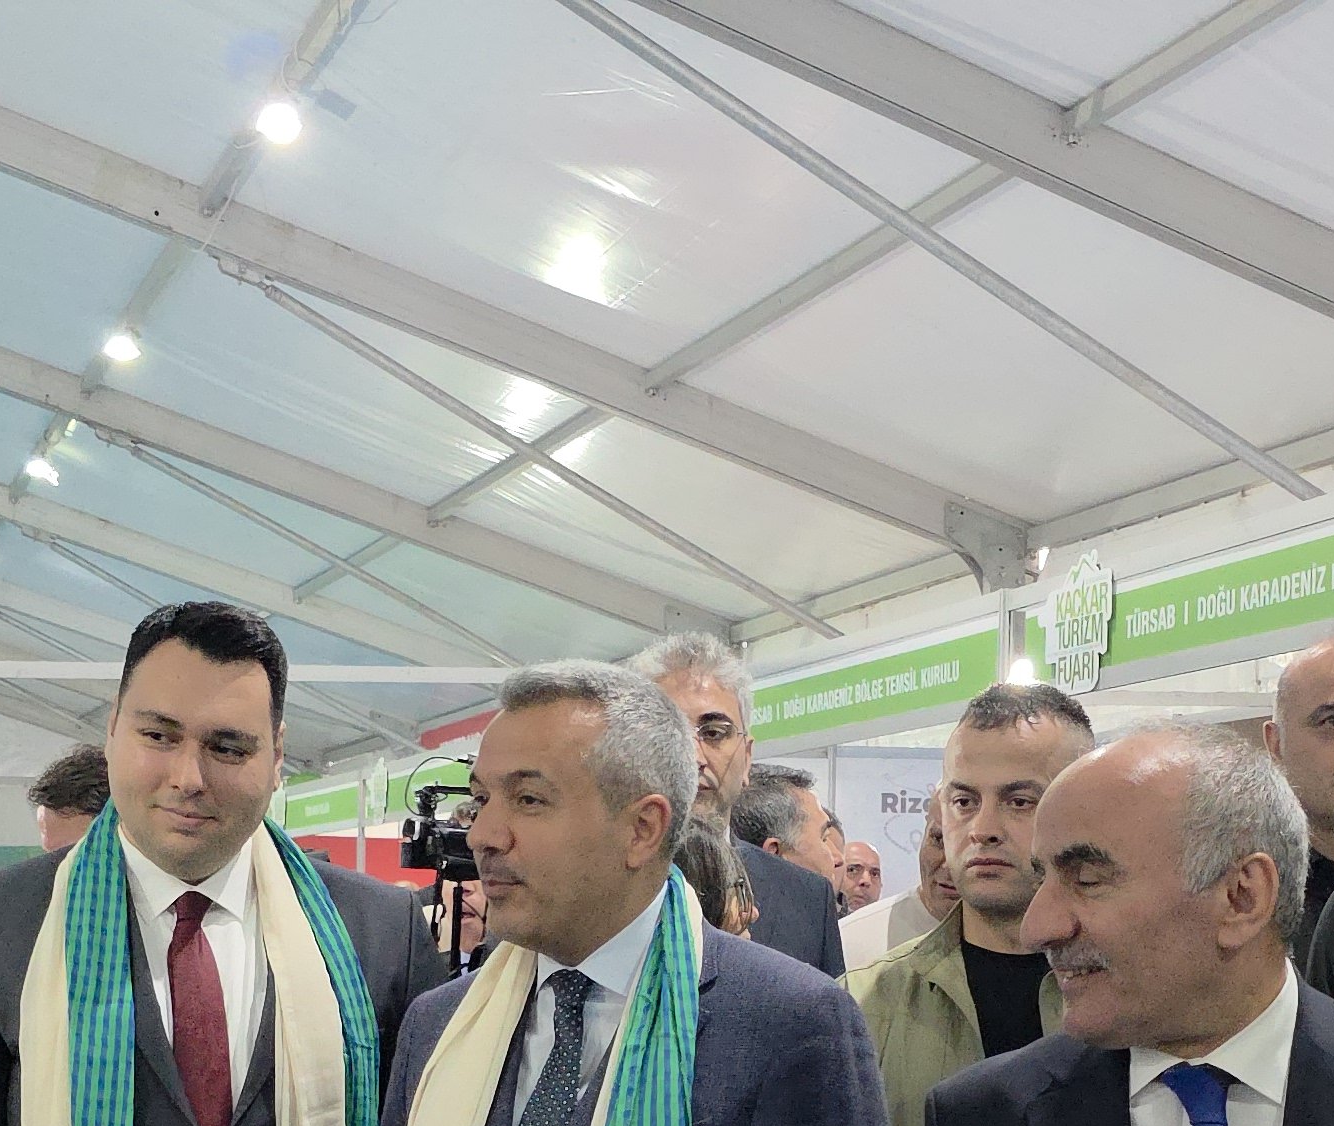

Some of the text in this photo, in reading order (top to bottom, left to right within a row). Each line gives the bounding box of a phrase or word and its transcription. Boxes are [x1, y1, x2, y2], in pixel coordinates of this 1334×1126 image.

[1125, 605, 1175, 639] TÜRSAB
[1197, 585, 1235, 622] DOĞU
[1240, 562, 1326, 613] KARADENİZ
